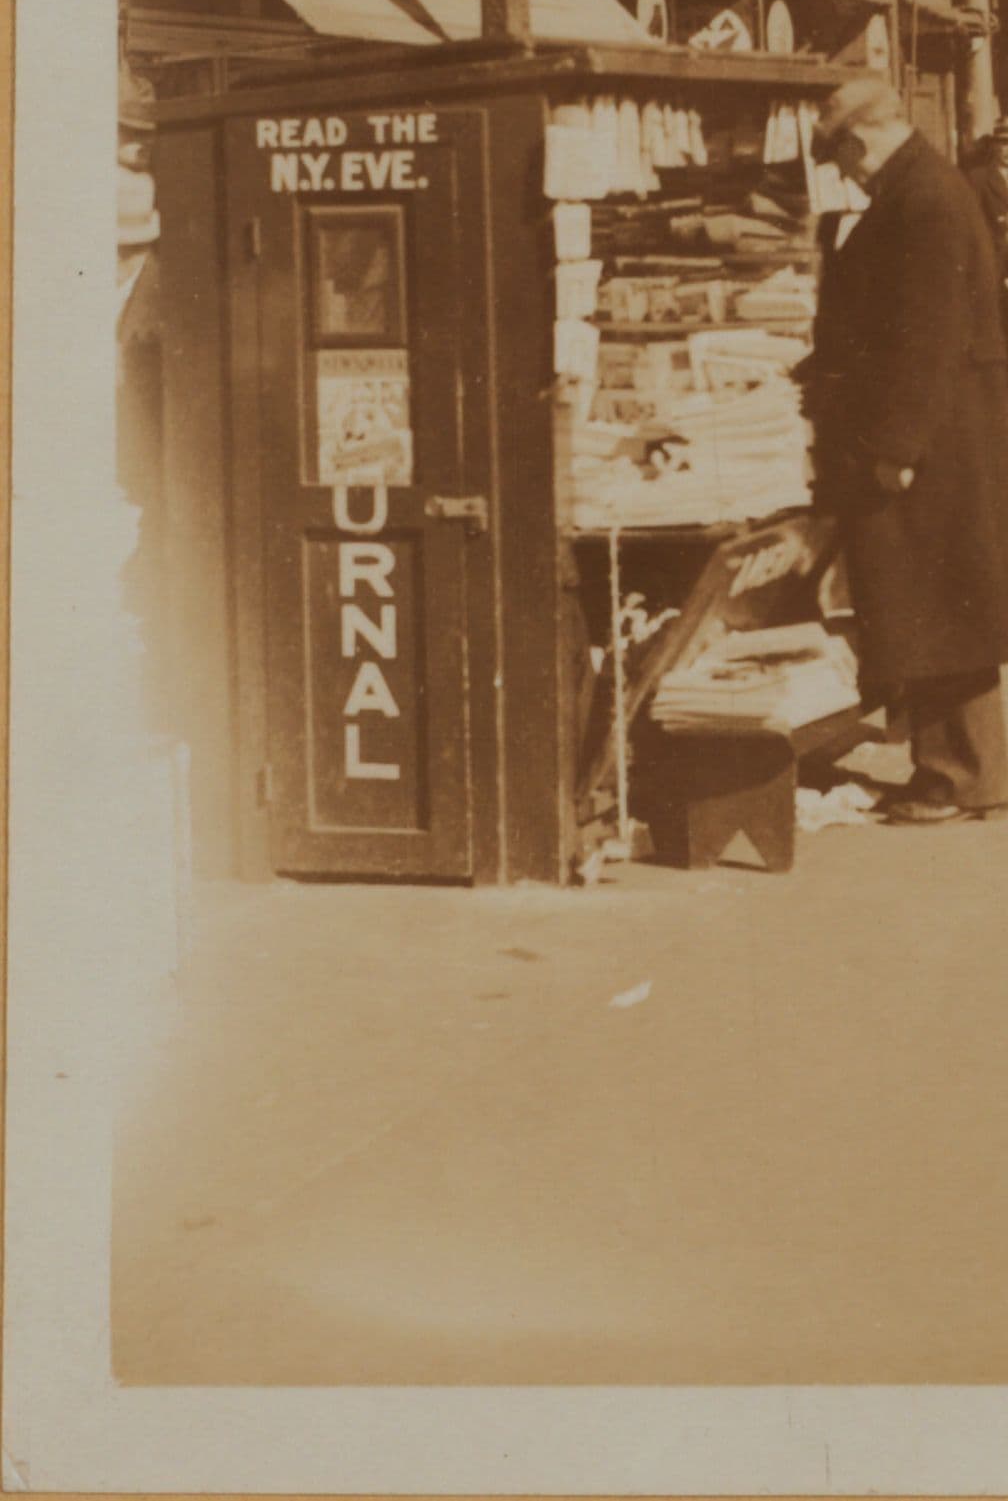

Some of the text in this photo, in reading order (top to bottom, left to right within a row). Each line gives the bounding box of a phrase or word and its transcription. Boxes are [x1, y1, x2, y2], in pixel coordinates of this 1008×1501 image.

[256, 114, 439, 148] READ THE
[270, 150, 429, 192] N.Y. EVE.
